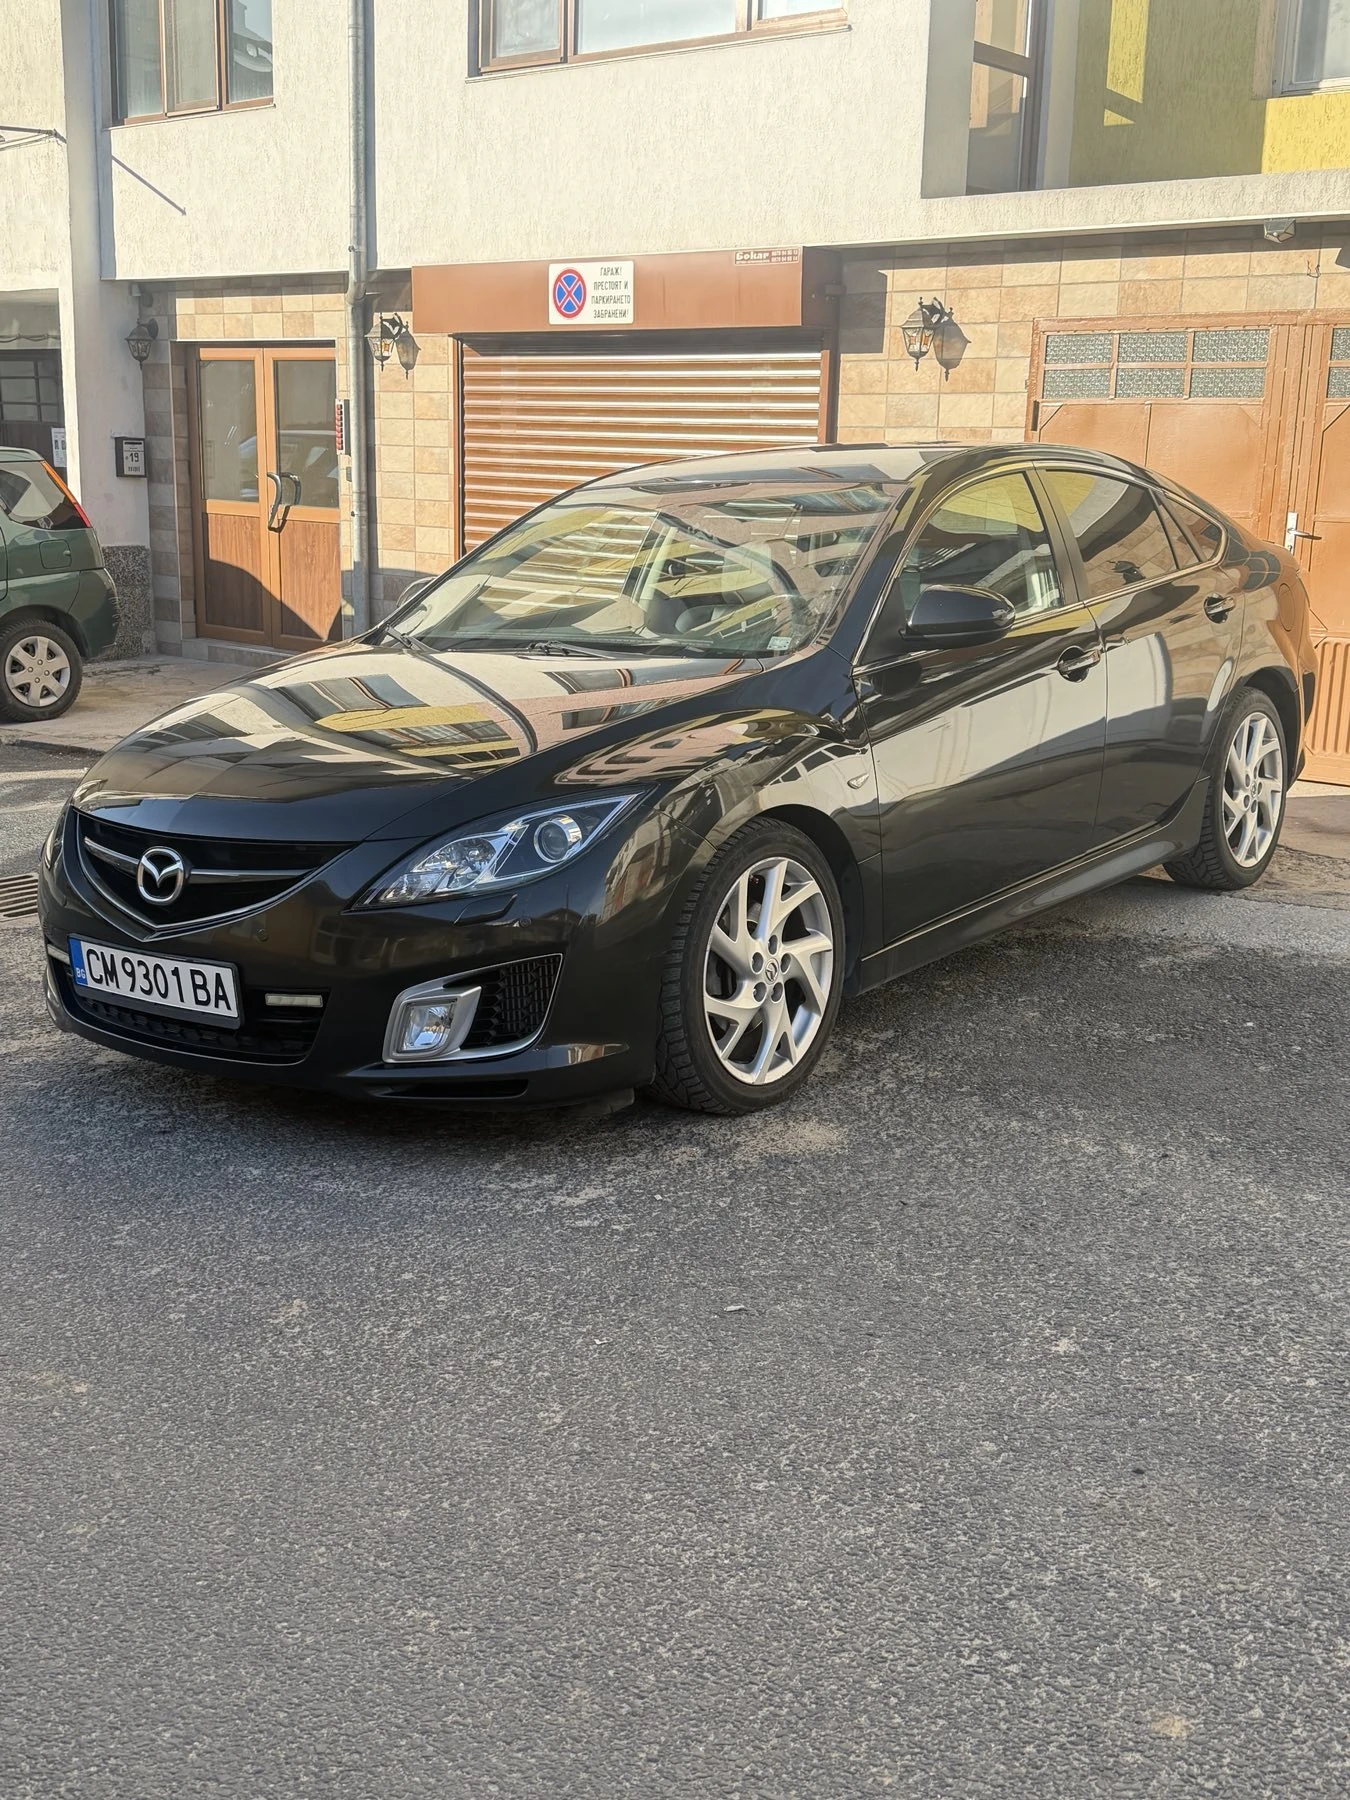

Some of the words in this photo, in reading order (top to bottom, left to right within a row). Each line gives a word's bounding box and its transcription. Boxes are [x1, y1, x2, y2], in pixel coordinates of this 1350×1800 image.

[600, 267, 622, 277] ГАРАЖ!
[593, 281, 622, 291] ПРЕСТОЯТ
[624, 280, 629, 290] И
[591, 294, 631, 305] ПАРКИРАНЕТО
[593, 308, 629, 319] ЗАБРАНЕНИ!
[129, 452, 140, 463] 19
[75, 967, 86, 979] BG
